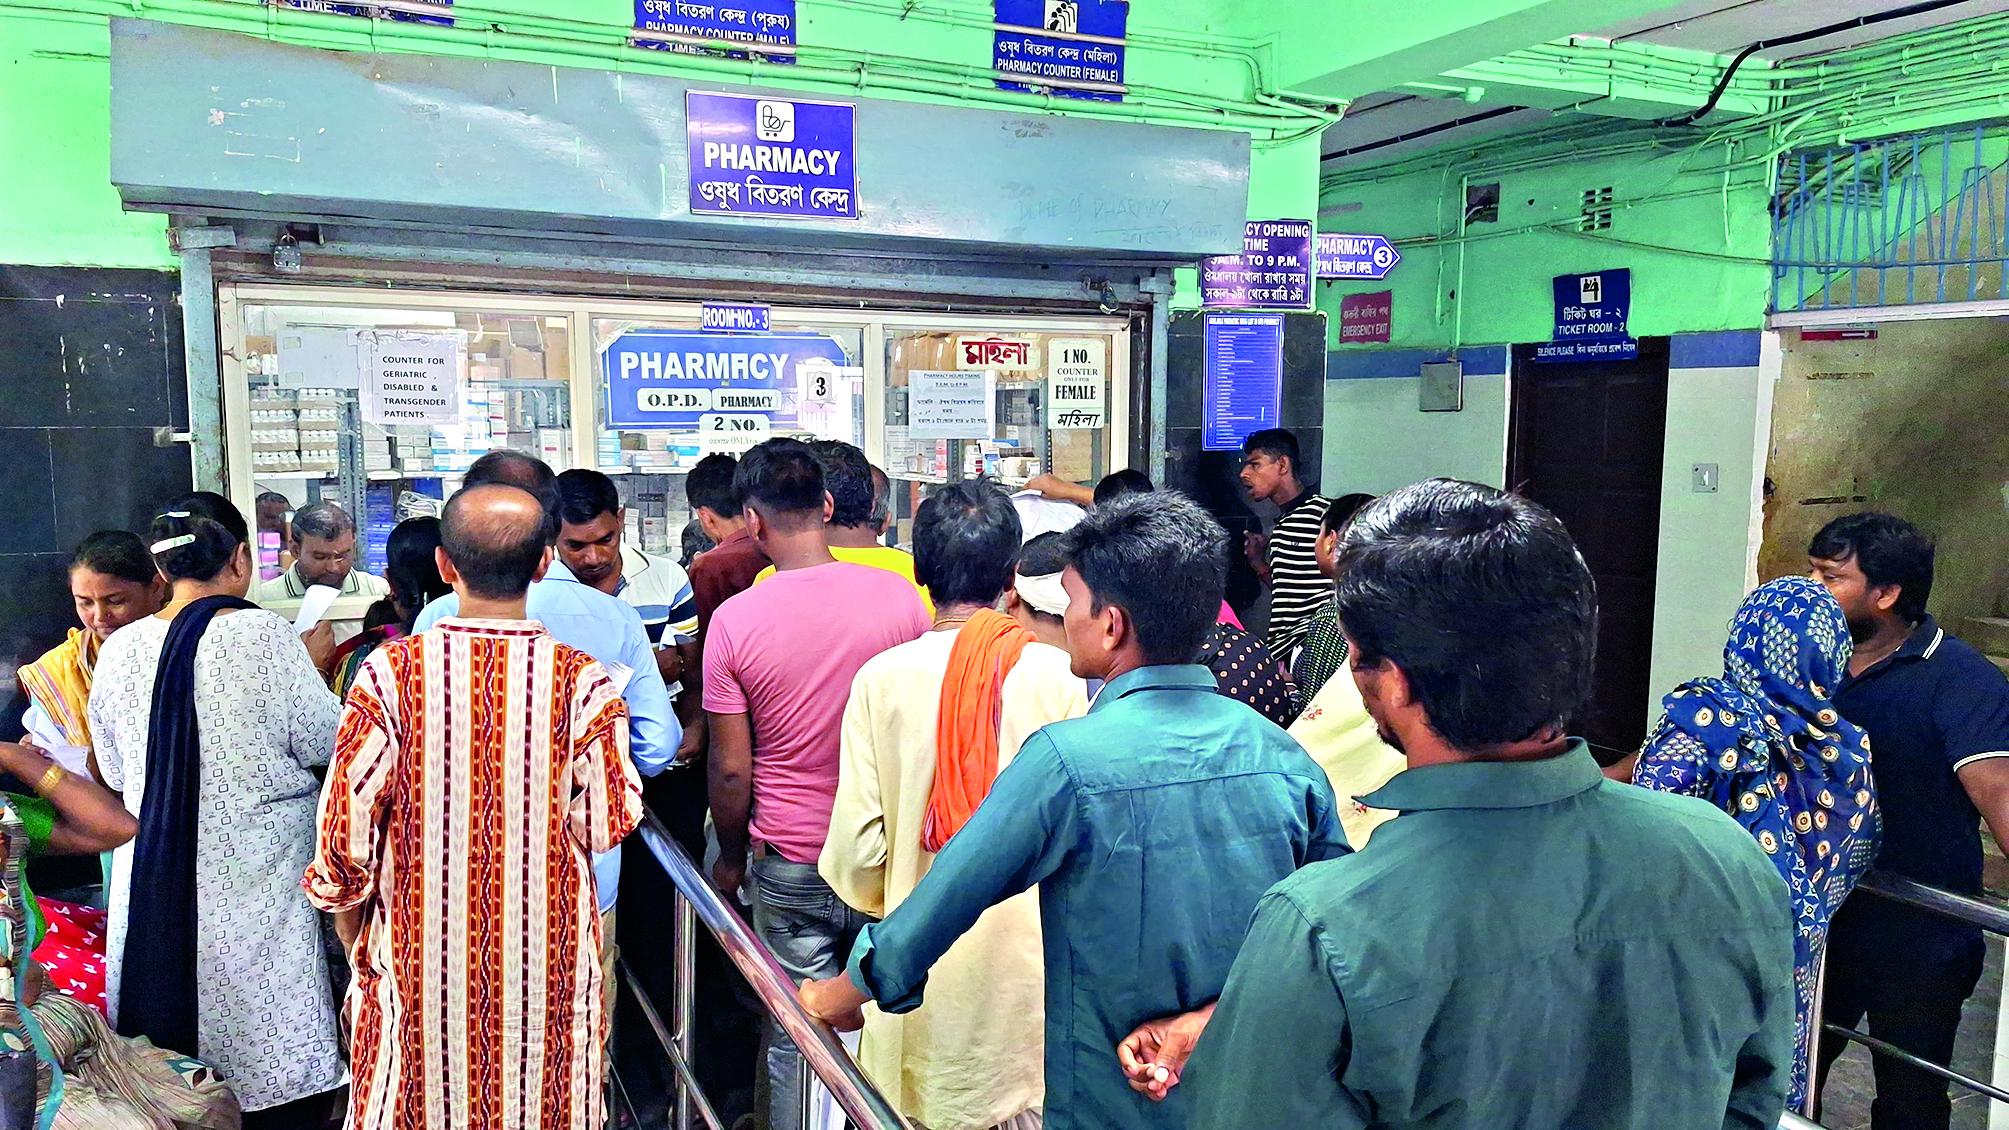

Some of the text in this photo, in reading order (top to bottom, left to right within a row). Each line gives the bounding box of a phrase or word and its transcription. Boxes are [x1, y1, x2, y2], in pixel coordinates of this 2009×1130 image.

[676, 0, 715, 21] বিতরণ
[719, 7, 747, 25] কেন্দ্র
[751, 10, 791, 32] (পুরুষ)
[1024, 39, 1054, 58] বিতরণ
[1058, 47, 1080, 60] কেন্দ্র
[1083, 47, 1118, 66] (মহিলা)
[998, 58, 1119, 84] PHARMACY COUNTER (FEMALE)
[704, 142, 841, 176] PHARMACY
[697, 174, 851, 215] ওষুধ বিতরণ কেন্দ্র
[1263, 224, 1309, 238] OPENING
[1244, 238, 1269, 251] TIME
[1316, 238, 1375, 255] PHARMACY
[1247, 255, 1264, 266] TO
[1267, 255, 1275, 267] 9
[1277, 256, 1301, 267] P.M.
[1378, 250, 1388, 264] 3
[1333, 257, 1355, 274] বিতরণ
[1240, 271, 1262, 284] খোলা
[1264, 271, 1286, 284] রাখার
[1288, 273, 1306, 285] সময়
[1205, 287, 1229, 300] সকাল
[1248, 289, 1269, 301] থেকে
[1271, 285, 1287, 301] রাত্রি
[703, 307, 735, 328] ROOM
[761, 310, 769, 329] 3
[1563, 306, 1587, 321] টিকিট
[1589, 308, 1602, 319] ঘর
[1615, 307, 1622, 318] ২
[1342, 323, 1388, 337] EMERGENCY EXIT
[1558, 323, 1586, 336] TICKET
[1587, 322, 1613, 334] ROOM
[1619, 322, 1624, 332] 2
[962, 337, 1031, 365] মহিলা
[1063, 349, 1091, 364] 1 NO.
[1537, 345, 1575, 357] SILENCE PLEASE
[382, 356, 423, 365] COUNTER
[620, 351, 790, 380] PHARMACY
[383, 370, 427, 379] GERIATRIC
[1057, 367, 1098, 376] COUNTER
[383, 383, 438, 392] DISABLED &
[816, 377, 826, 396] 3
[1055, 385, 1096, 400] FEMALE
[384, 397, 446, 406] TRANSGENDER
[647, 393, 702, 407] O.P.D.
[720, 395, 773, 408] PHARMACY
[714, 416, 760, 431] 2 NO.
[1057, 409, 1101, 428] মহিলা
[730, 437, 749, 445] ONLY
